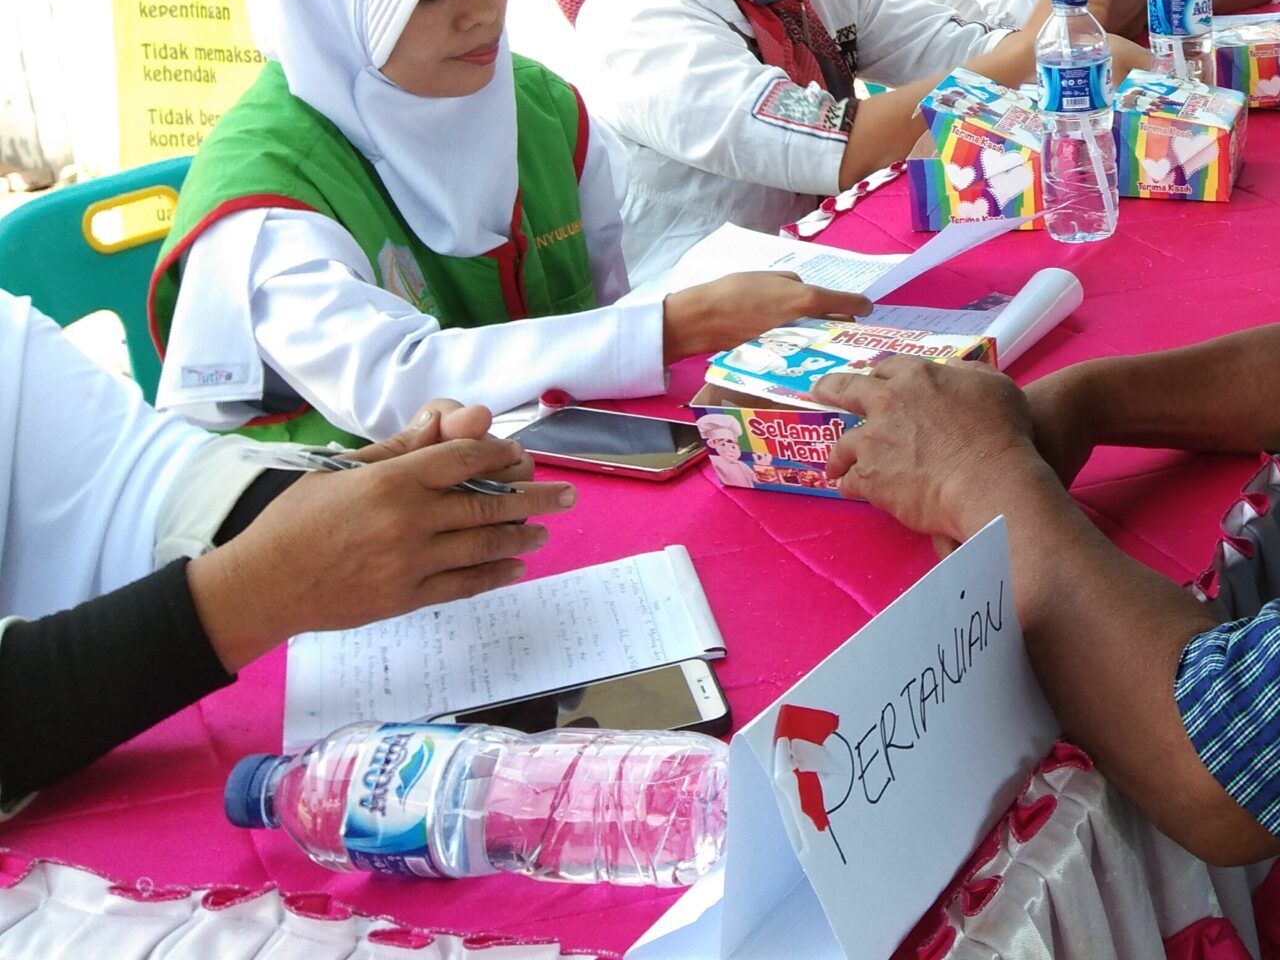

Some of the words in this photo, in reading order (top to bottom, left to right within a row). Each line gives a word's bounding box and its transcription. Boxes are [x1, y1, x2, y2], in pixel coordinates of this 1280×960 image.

[138, 1, 231, 21] kepentingan
[141, 43, 190, 60] Tidak
[143, 65, 217, 83] kehendak
[147, 108, 194, 126] Tidak
